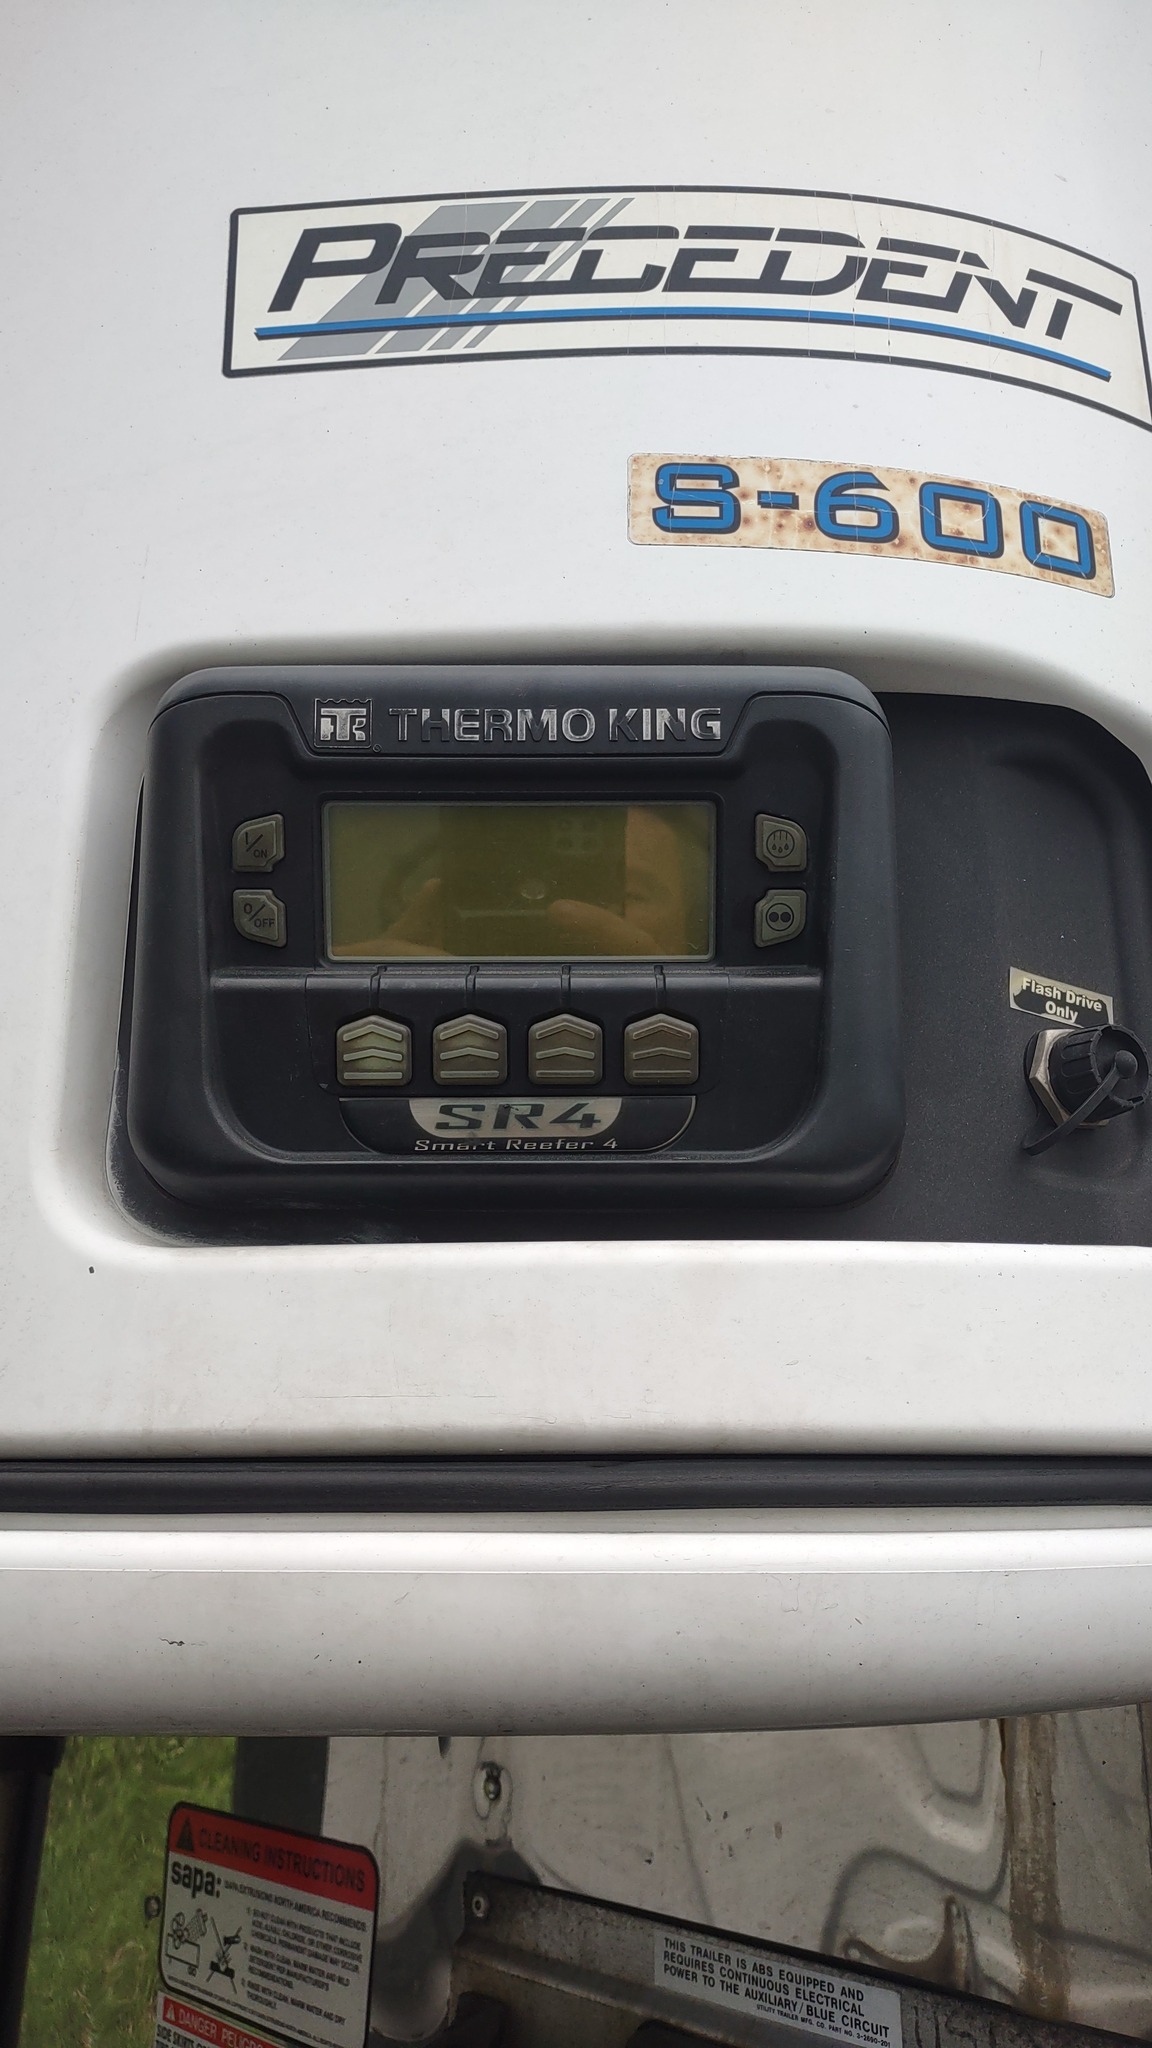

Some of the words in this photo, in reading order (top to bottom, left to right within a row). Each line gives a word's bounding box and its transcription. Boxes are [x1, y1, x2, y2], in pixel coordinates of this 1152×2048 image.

[268, 221, 1122, 341] PRECEDENT
[651, 461, 1096, 580] S-600
[388, 707, 596, 743] THERMO
[608, 707, 722, 742] KING
[1022, 977, 1062, 1000] Flash
[1065, 990, 1102, 1012] Drive
[1045, 1002, 1078, 1023] Only
[435, 1103, 601, 1130] SR4
[415, 1139, 496, 1151] Smart
[506, 1139, 594, 1150] Reefer
[603, 1138, 618, 1149] 4
[200, 1828, 260, 1862] CLEANING
[264, 1845, 365, 1892] INSTRUCTIONS
[663, 1950, 715, 1974] REQUIRES
[720, 1966, 789, 1996] CONTINUOUS
[795, 1988, 865, 2017] ELECTRICAL
[664, 1937, 686, 1953] THIS
[690, 1944, 731, 1966] TRAILER
[736, 1957, 747, 1970] IS
[752, 1962, 773, 1977] ABS
[779, 1969, 835, 1994] EQUIPPED
[840, 1986, 864, 2002] AND
[663, 1963, 698, 1983] POWER
[702, 1974, 716, 1988] TO
[720, 1979, 740, 1995] THE
[841, 2015, 890, 2038] CIRCUIT
[756, 2003, 775, 2014] UTILITY
[777, 2009, 799, 2021] TRAILER
[828, 2024, 842, 2034] PART
[178, 2009, 217, 2039] DANGER
[221, 2028, 263, 2048] PELIGR
